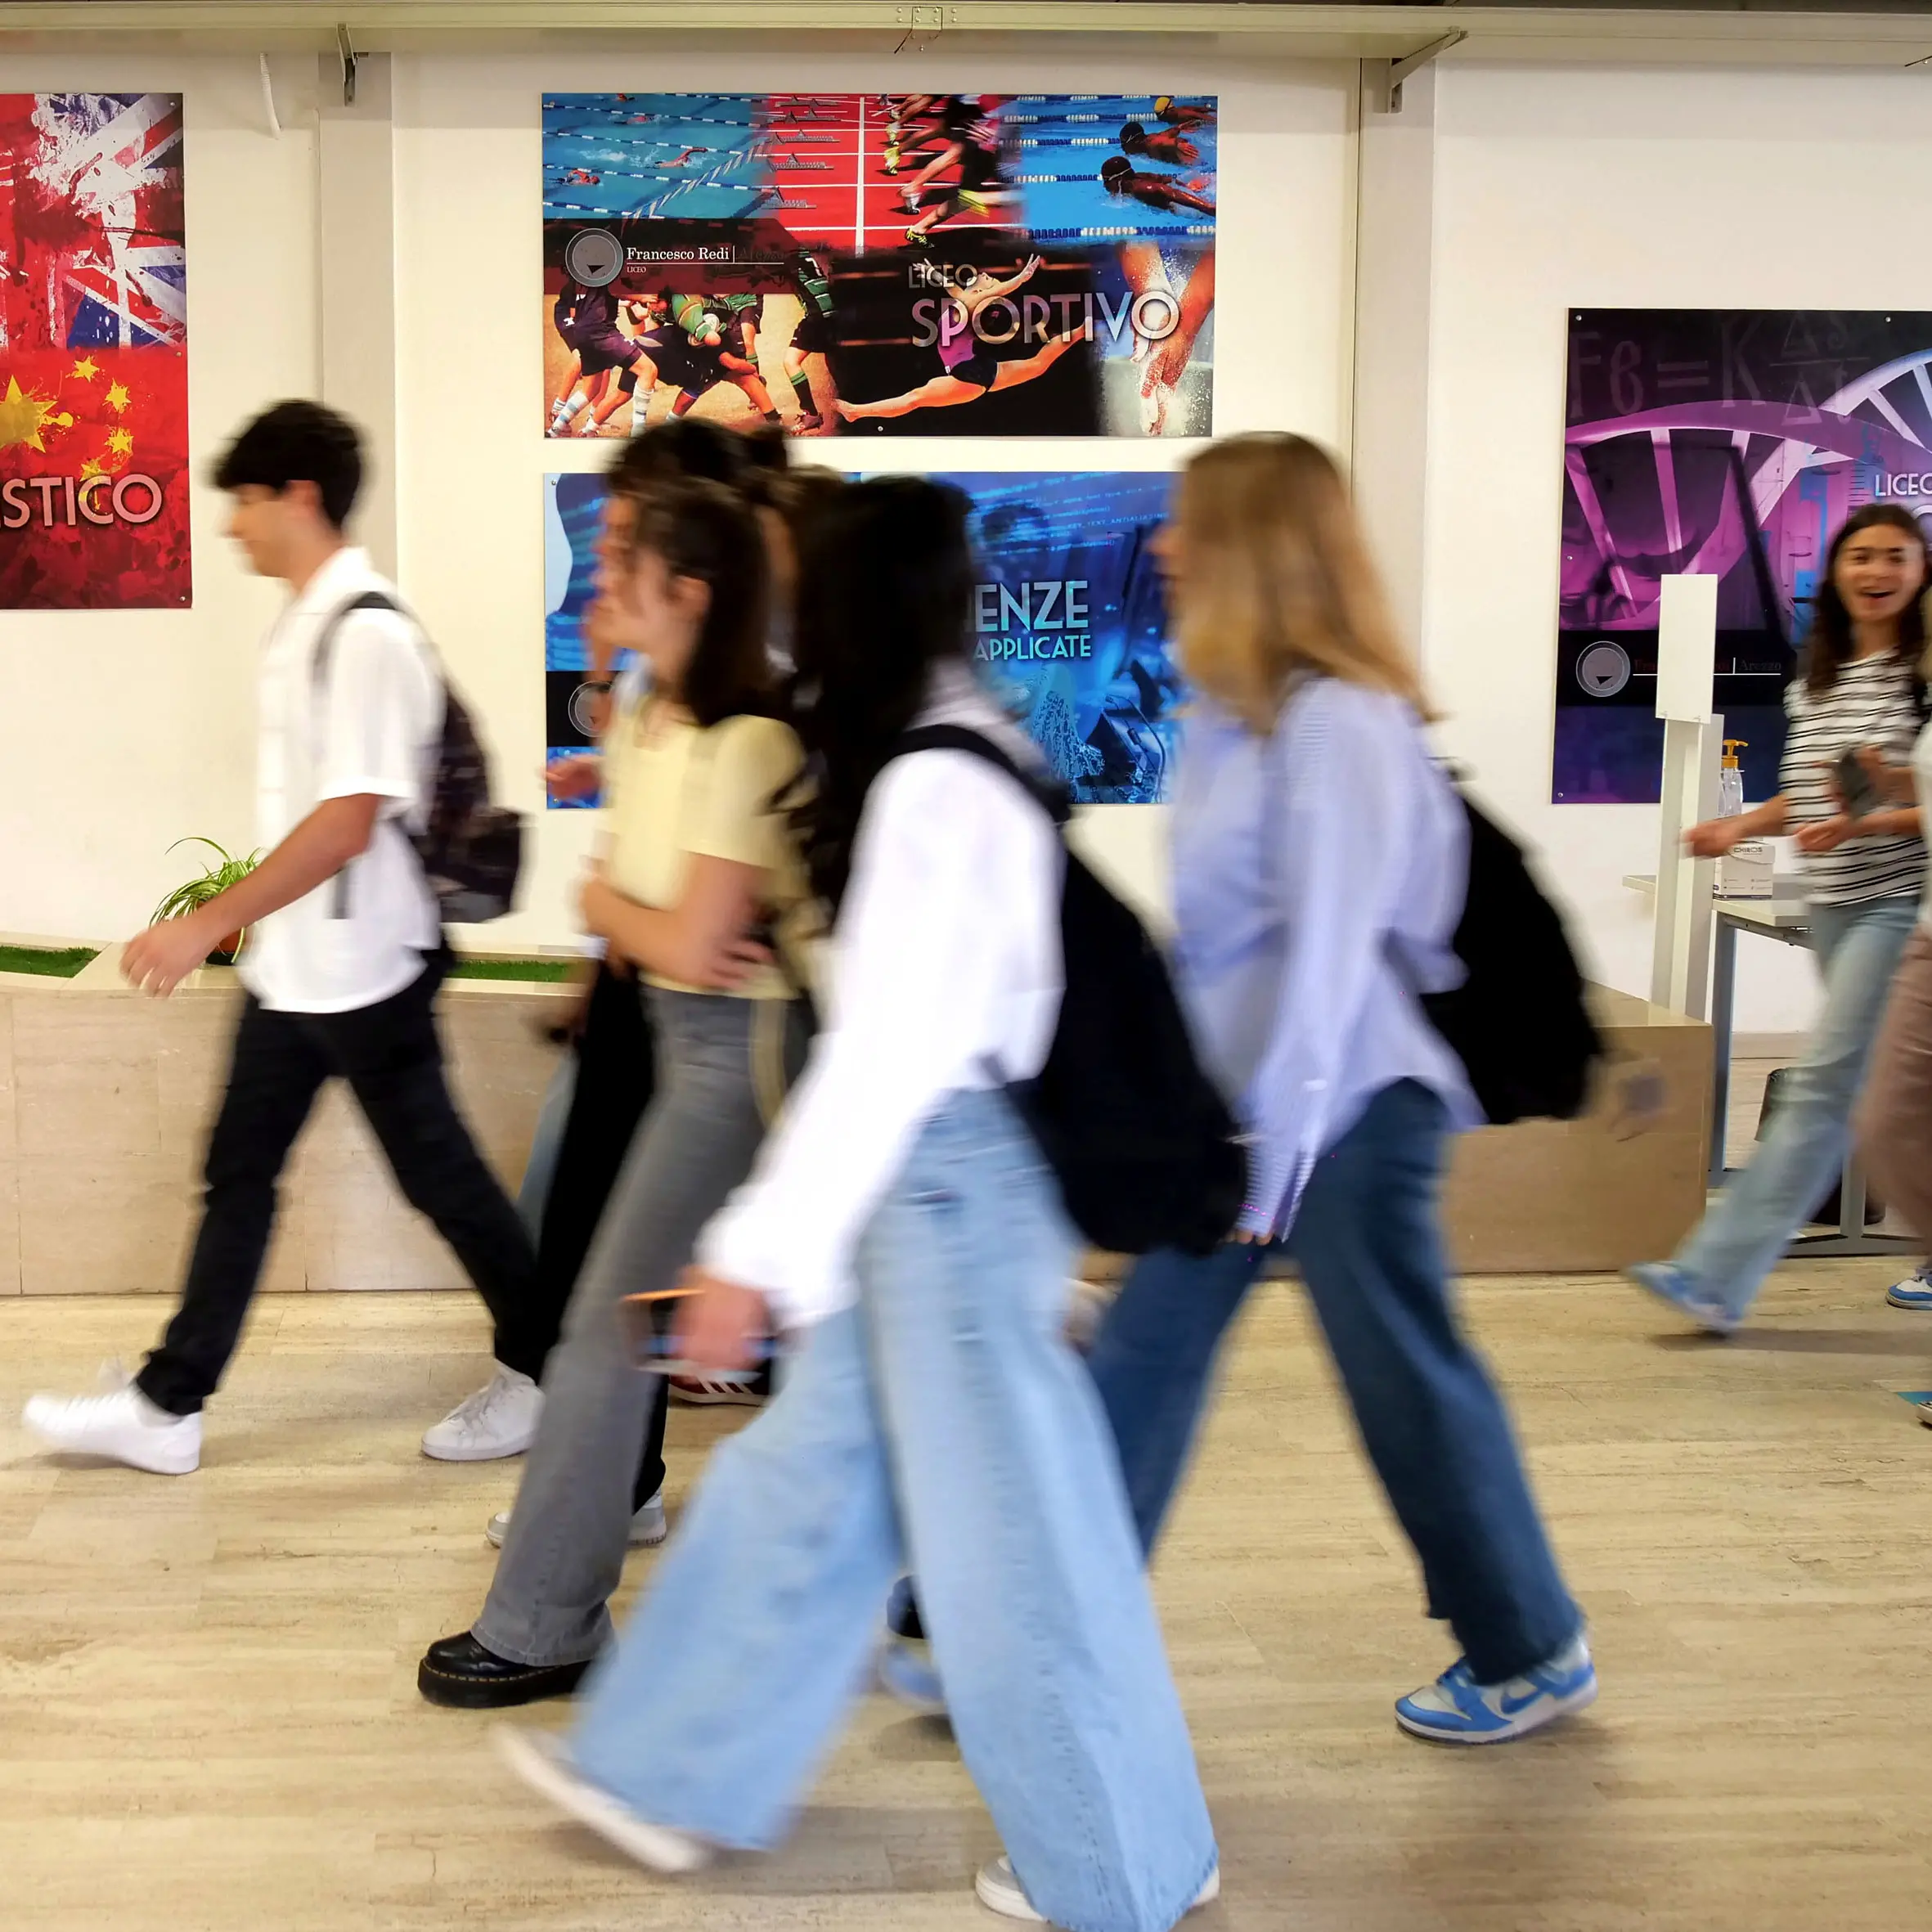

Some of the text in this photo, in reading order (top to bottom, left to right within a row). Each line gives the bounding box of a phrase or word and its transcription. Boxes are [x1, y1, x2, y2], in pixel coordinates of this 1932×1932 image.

[627, 247, 694, 260] Francesco
[699, 247, 730, 260] Redi
[909, 263, 977, 289] LICEO
[911, 290, 1180, 347] SPORTIVO
[0, 474, 163, 529] STICO
[971, 580, 1089, 631] ENZE
[974, 634, 1091, 661] APPLICATE
